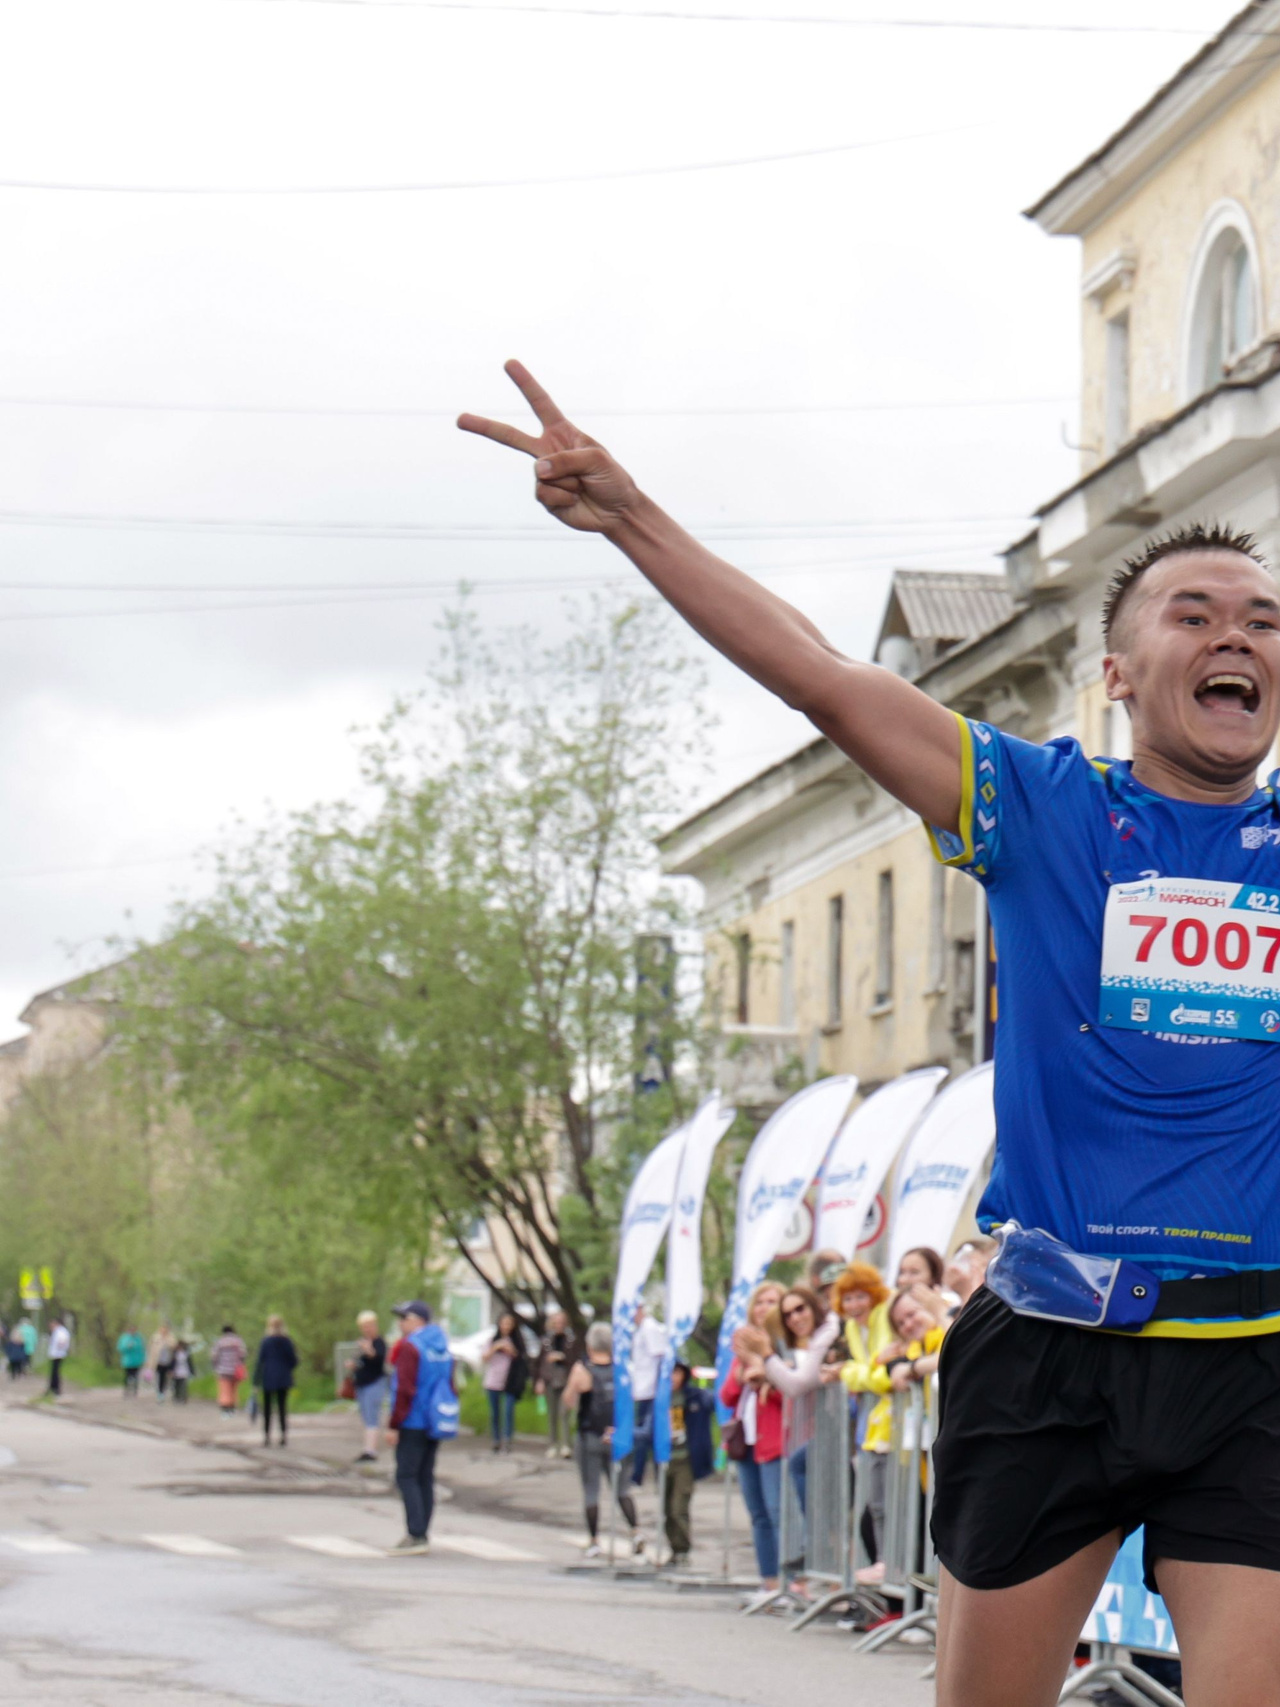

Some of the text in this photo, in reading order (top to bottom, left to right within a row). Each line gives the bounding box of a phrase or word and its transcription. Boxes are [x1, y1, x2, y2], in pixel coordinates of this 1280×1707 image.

[1159, 893, 1226, 908] МАРАФОН
[1246, 892, 1280, 913] 42,2
[1214, 1009, 1236, 1025] 55
[1087, 1224, 1252, 1244] ТВОЙ СПОРТ. ТВОИ ПРАВИЛА
